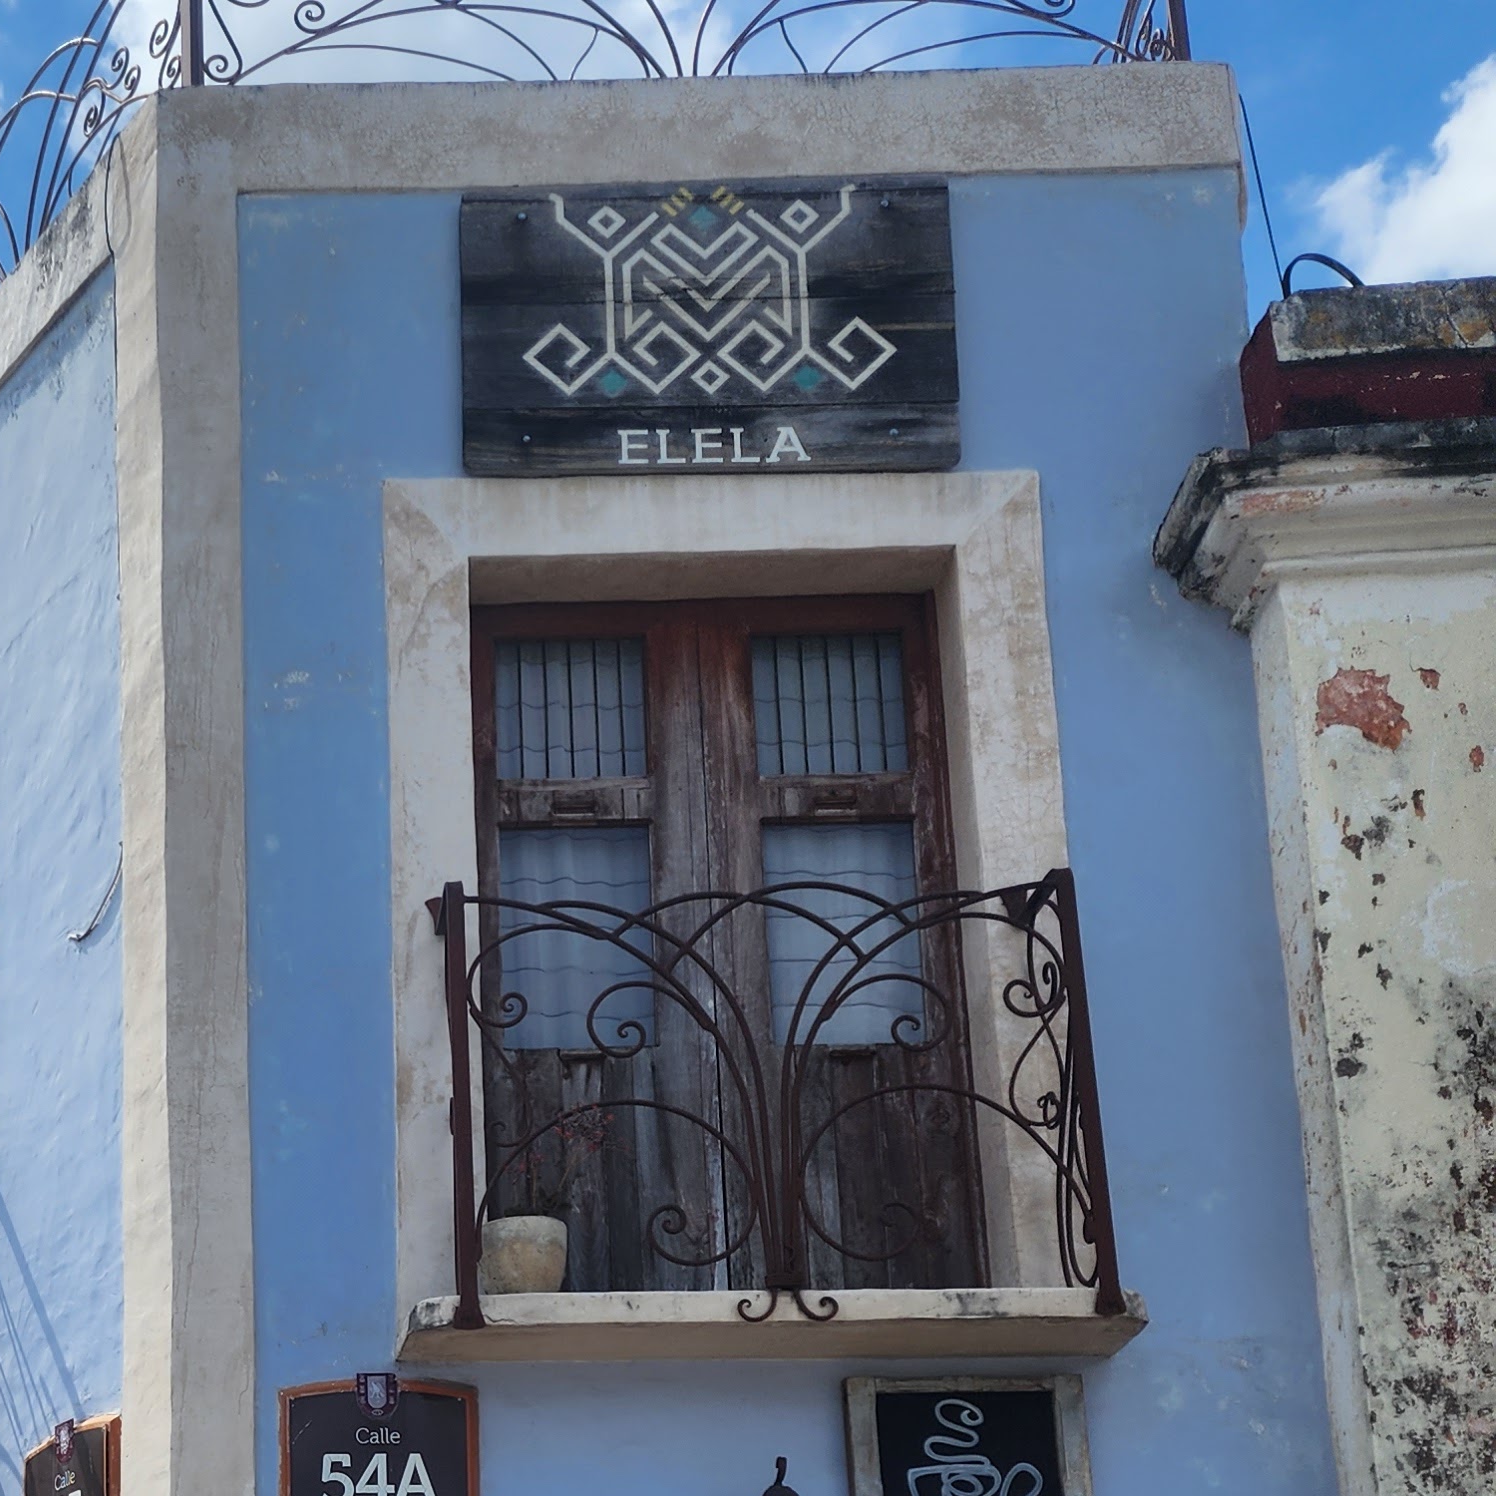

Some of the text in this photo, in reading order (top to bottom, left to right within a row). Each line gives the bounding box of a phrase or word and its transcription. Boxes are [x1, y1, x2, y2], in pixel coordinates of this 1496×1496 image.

[617, 427, 811, 465] ELELA
[355, 1427, 401, 1445] Calle
[54, 1469, 76, 1492] Calle
